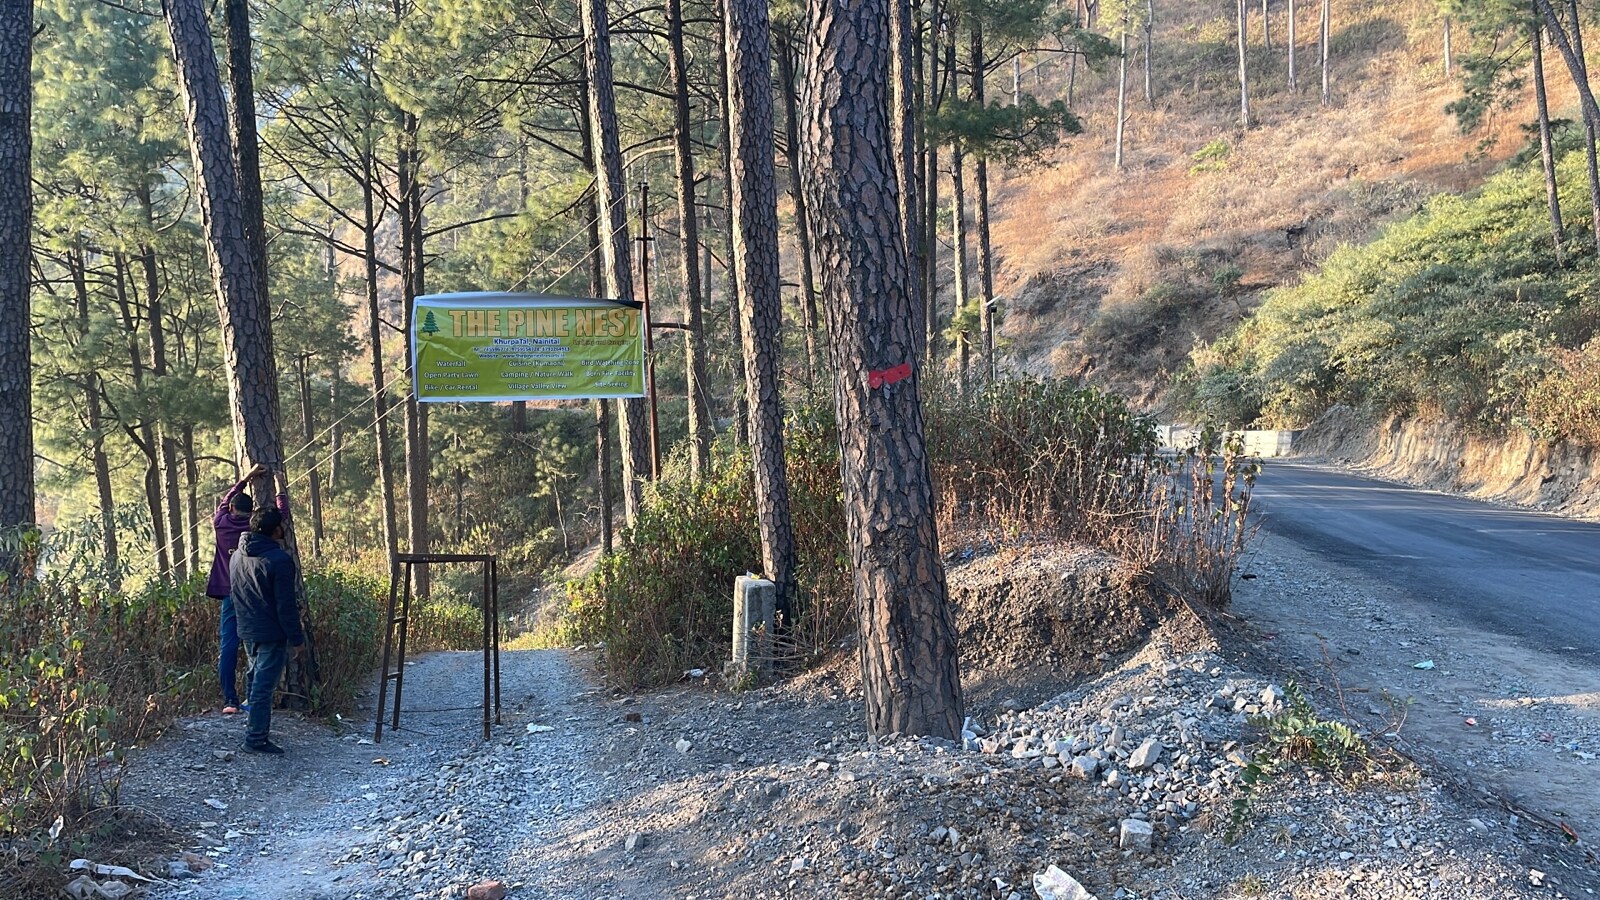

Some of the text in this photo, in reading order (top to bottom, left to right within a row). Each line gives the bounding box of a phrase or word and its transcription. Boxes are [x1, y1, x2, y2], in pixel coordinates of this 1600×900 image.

[449, 308, 642, 338] THE PINE NEST
